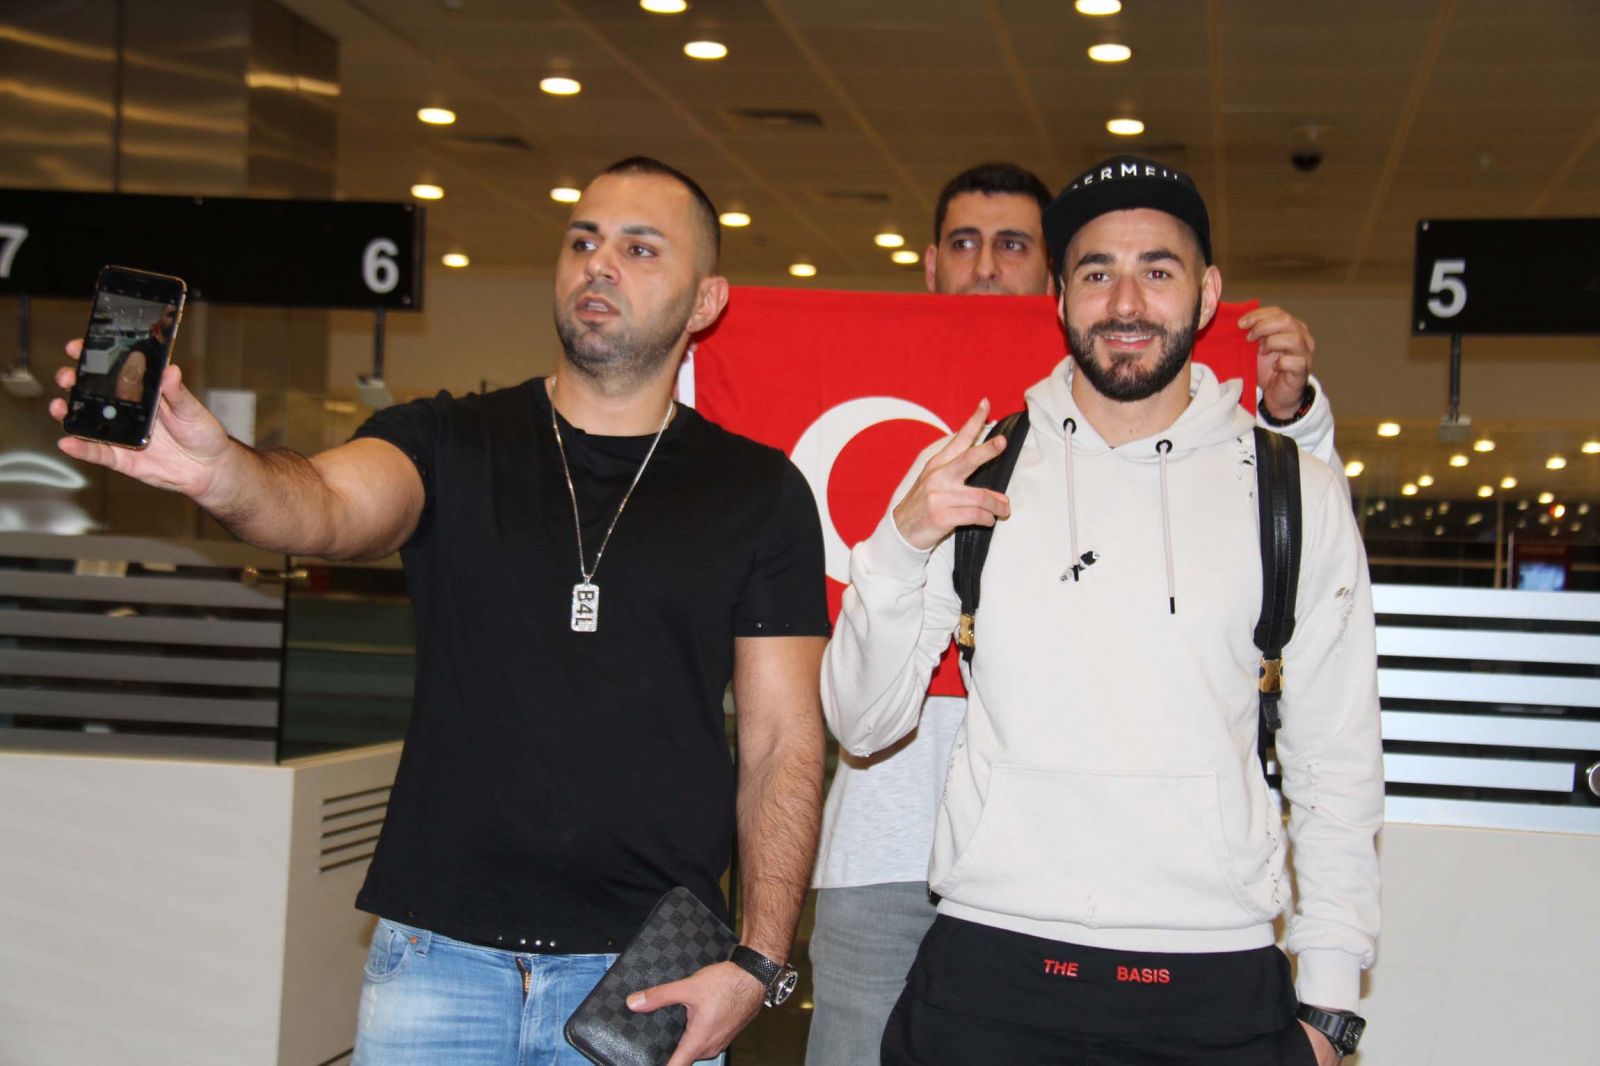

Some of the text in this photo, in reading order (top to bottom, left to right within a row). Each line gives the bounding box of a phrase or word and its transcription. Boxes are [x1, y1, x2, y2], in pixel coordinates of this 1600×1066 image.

[0, 223, 29, 278] 7
[362, 238, 399, 294] 6
[1427, 258, 1467, 318] 5
[575, 590, 595, 626] B4L
[1043, 959, 1170, 983] THE BASIS
